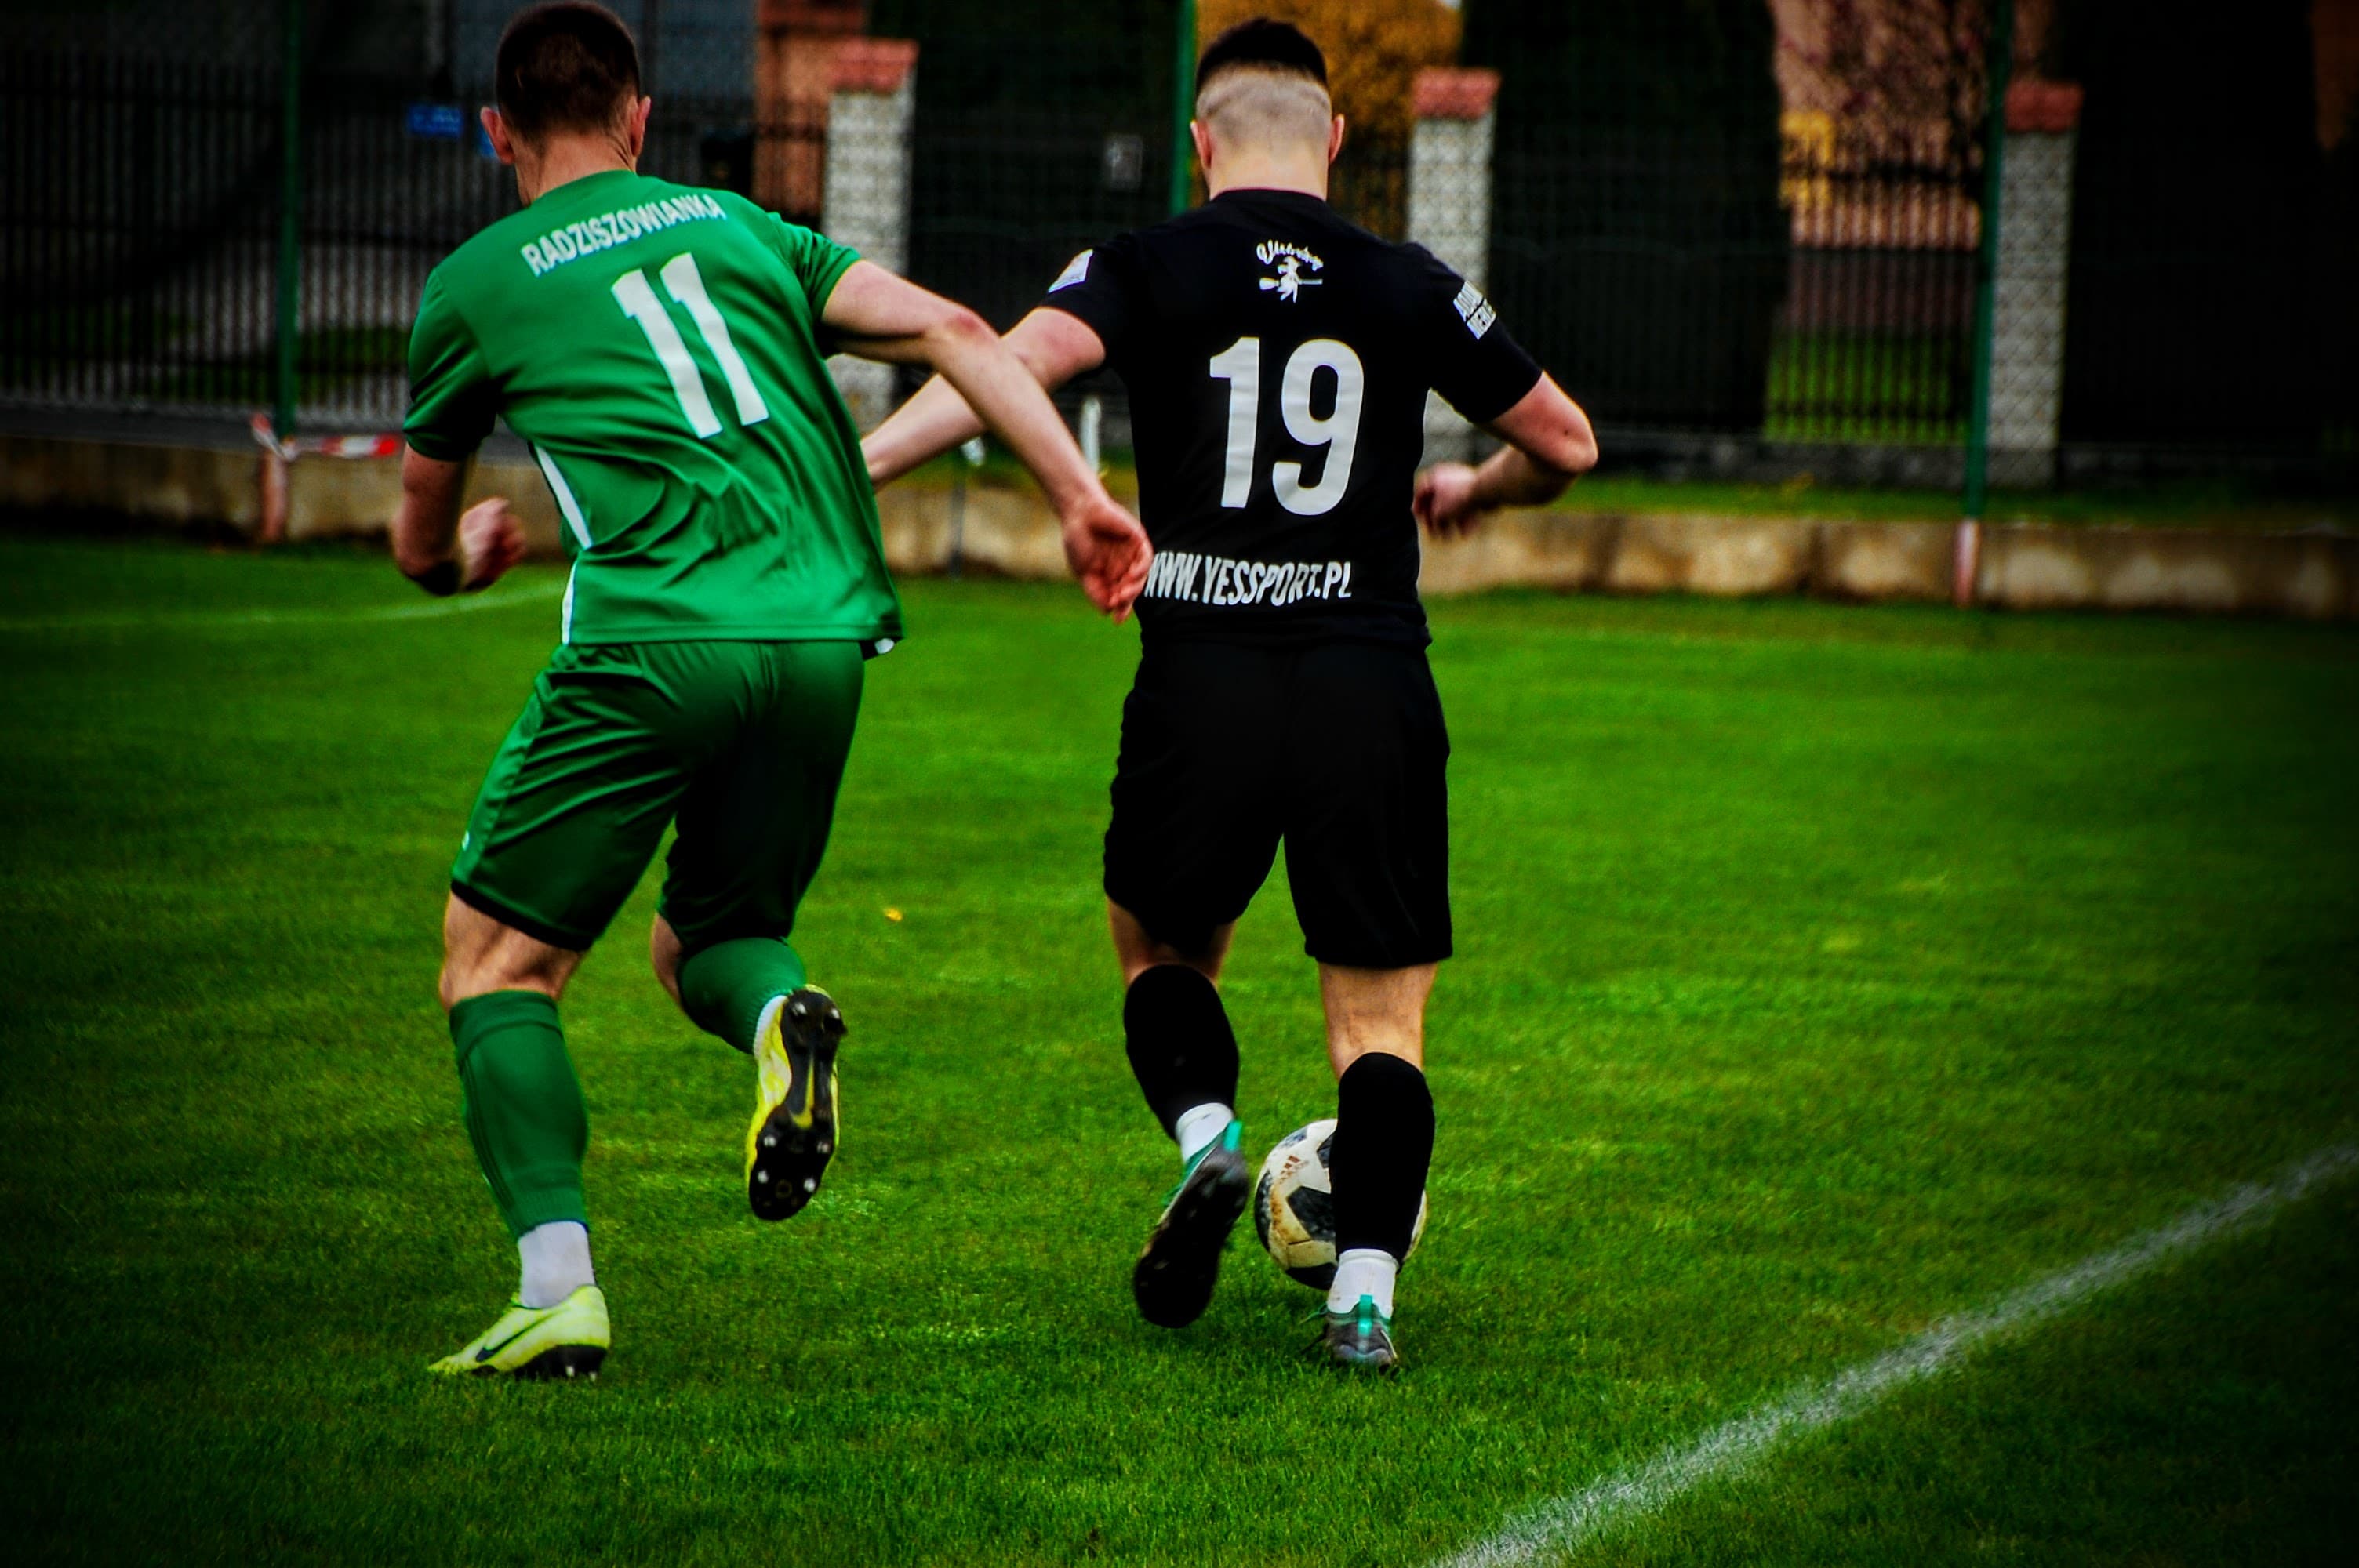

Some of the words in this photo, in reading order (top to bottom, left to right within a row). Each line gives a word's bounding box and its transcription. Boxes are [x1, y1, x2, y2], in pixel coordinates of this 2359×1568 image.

[520, 194, 727, 278] RADZISZOWIANKA
[611, 252, 769, 439] 11
[1209, 336, 1365, 516] 19
[1143, 550, 1352, 607] WWW.YESSPORT.PL
